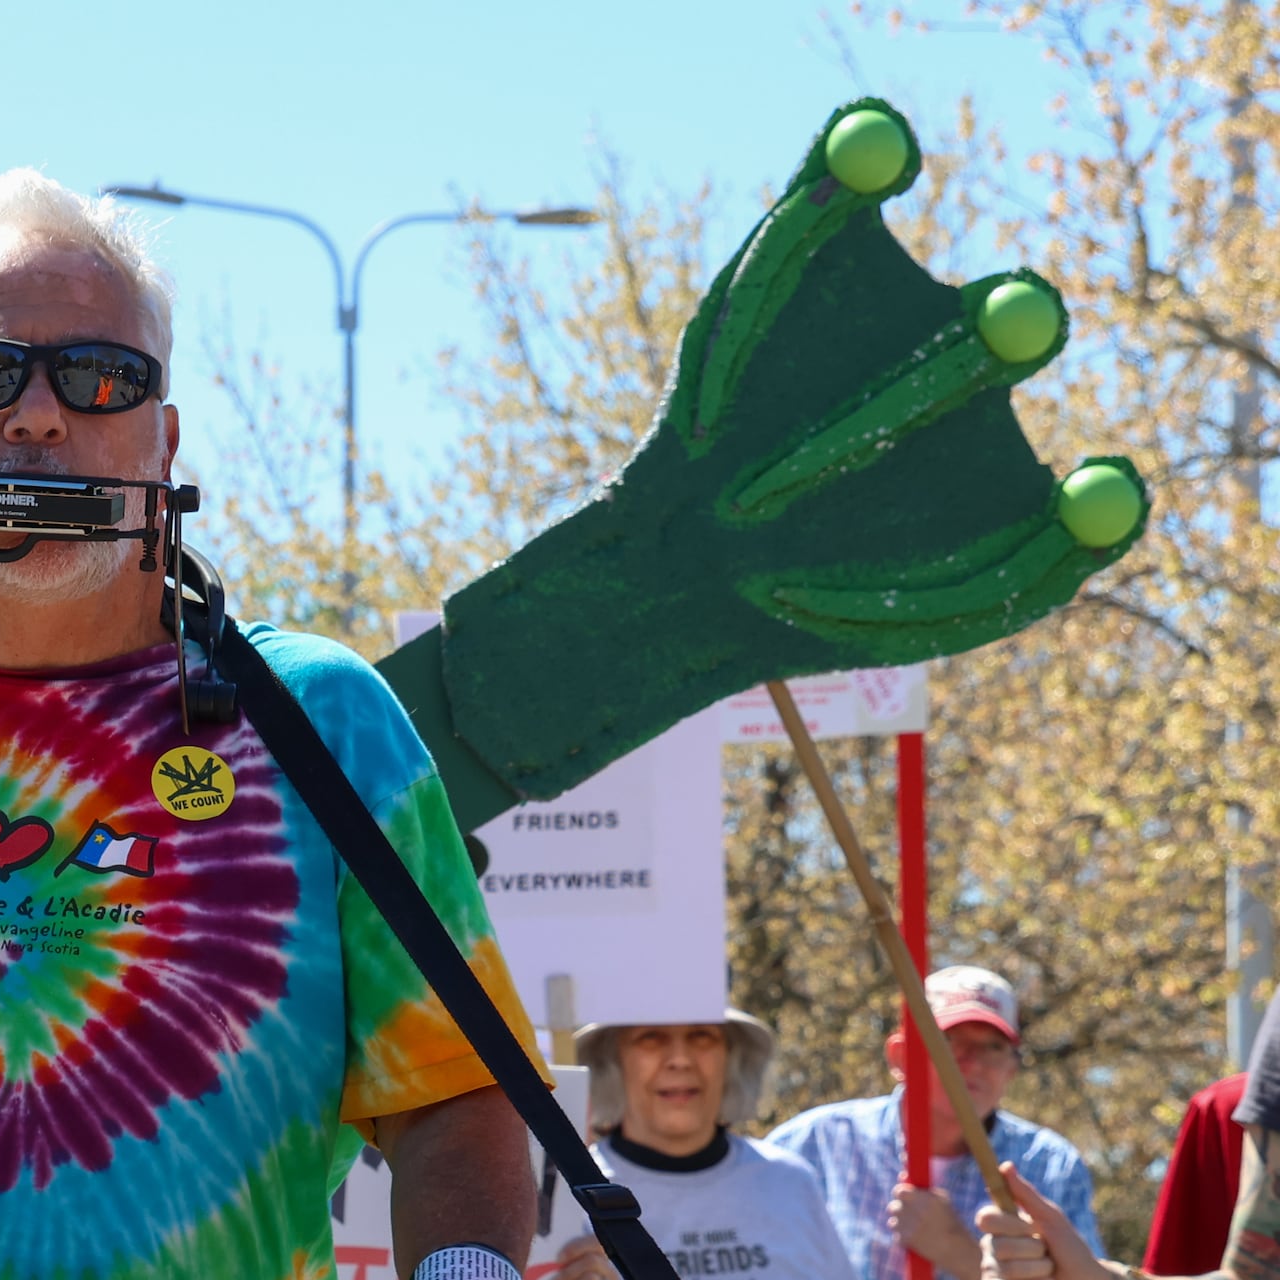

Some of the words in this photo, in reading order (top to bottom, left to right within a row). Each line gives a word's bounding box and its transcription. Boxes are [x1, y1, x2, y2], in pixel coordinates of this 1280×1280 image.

[170, 799, 189, 812] WE
[190, 793, 225, 809] COUNT
[511, 809, 621, 832] FRIENDS
[483, 868, 652, 893] EVERYWHERE
[16, 895, 34, 919] &
[43, 896, 146, 926] L'Acadie
[0, 938, 34, 954] Nova
[40, 940, 80, 957] Scotia
